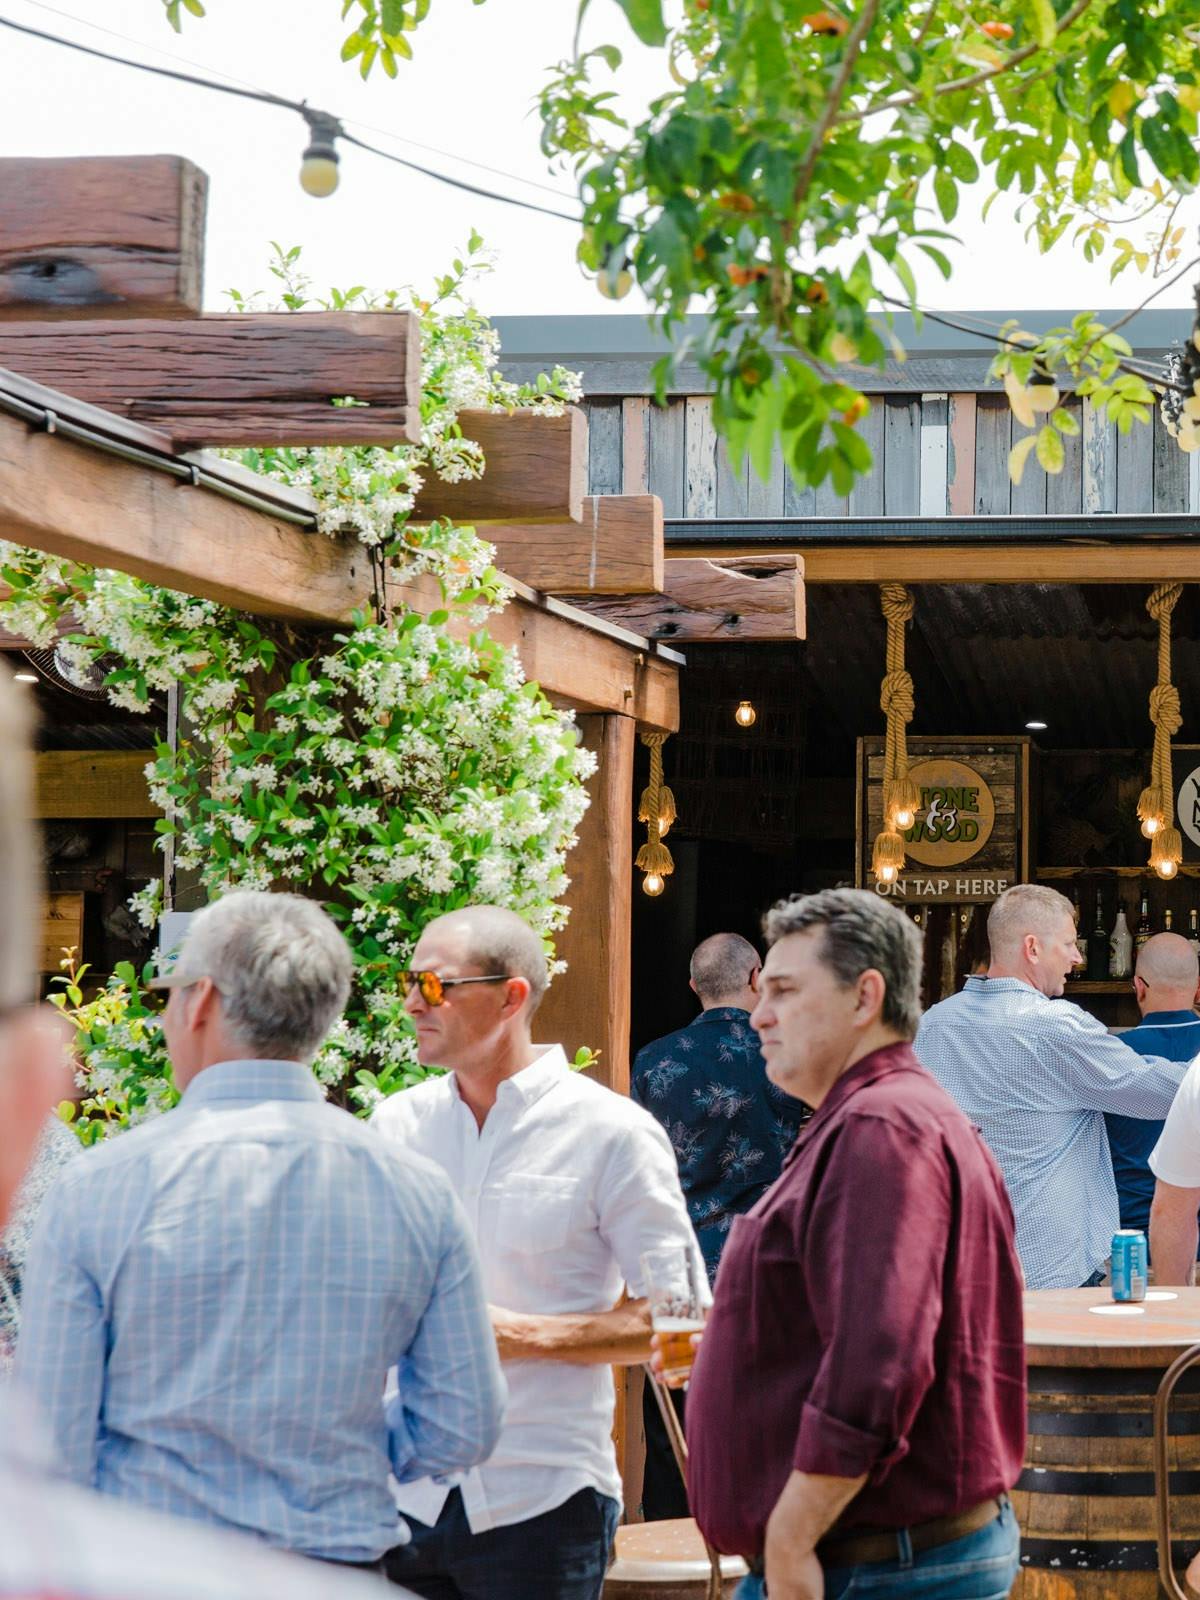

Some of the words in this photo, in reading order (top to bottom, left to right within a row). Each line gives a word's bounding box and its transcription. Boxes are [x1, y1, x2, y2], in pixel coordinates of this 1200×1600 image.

[919, 787, 979, 813] TONE
[926, 799, 958, 832] &
[875, 880, 906, 896] ON
[913, 880, 950, 895] TAP
[956, 880, 1007, 895] HERE
